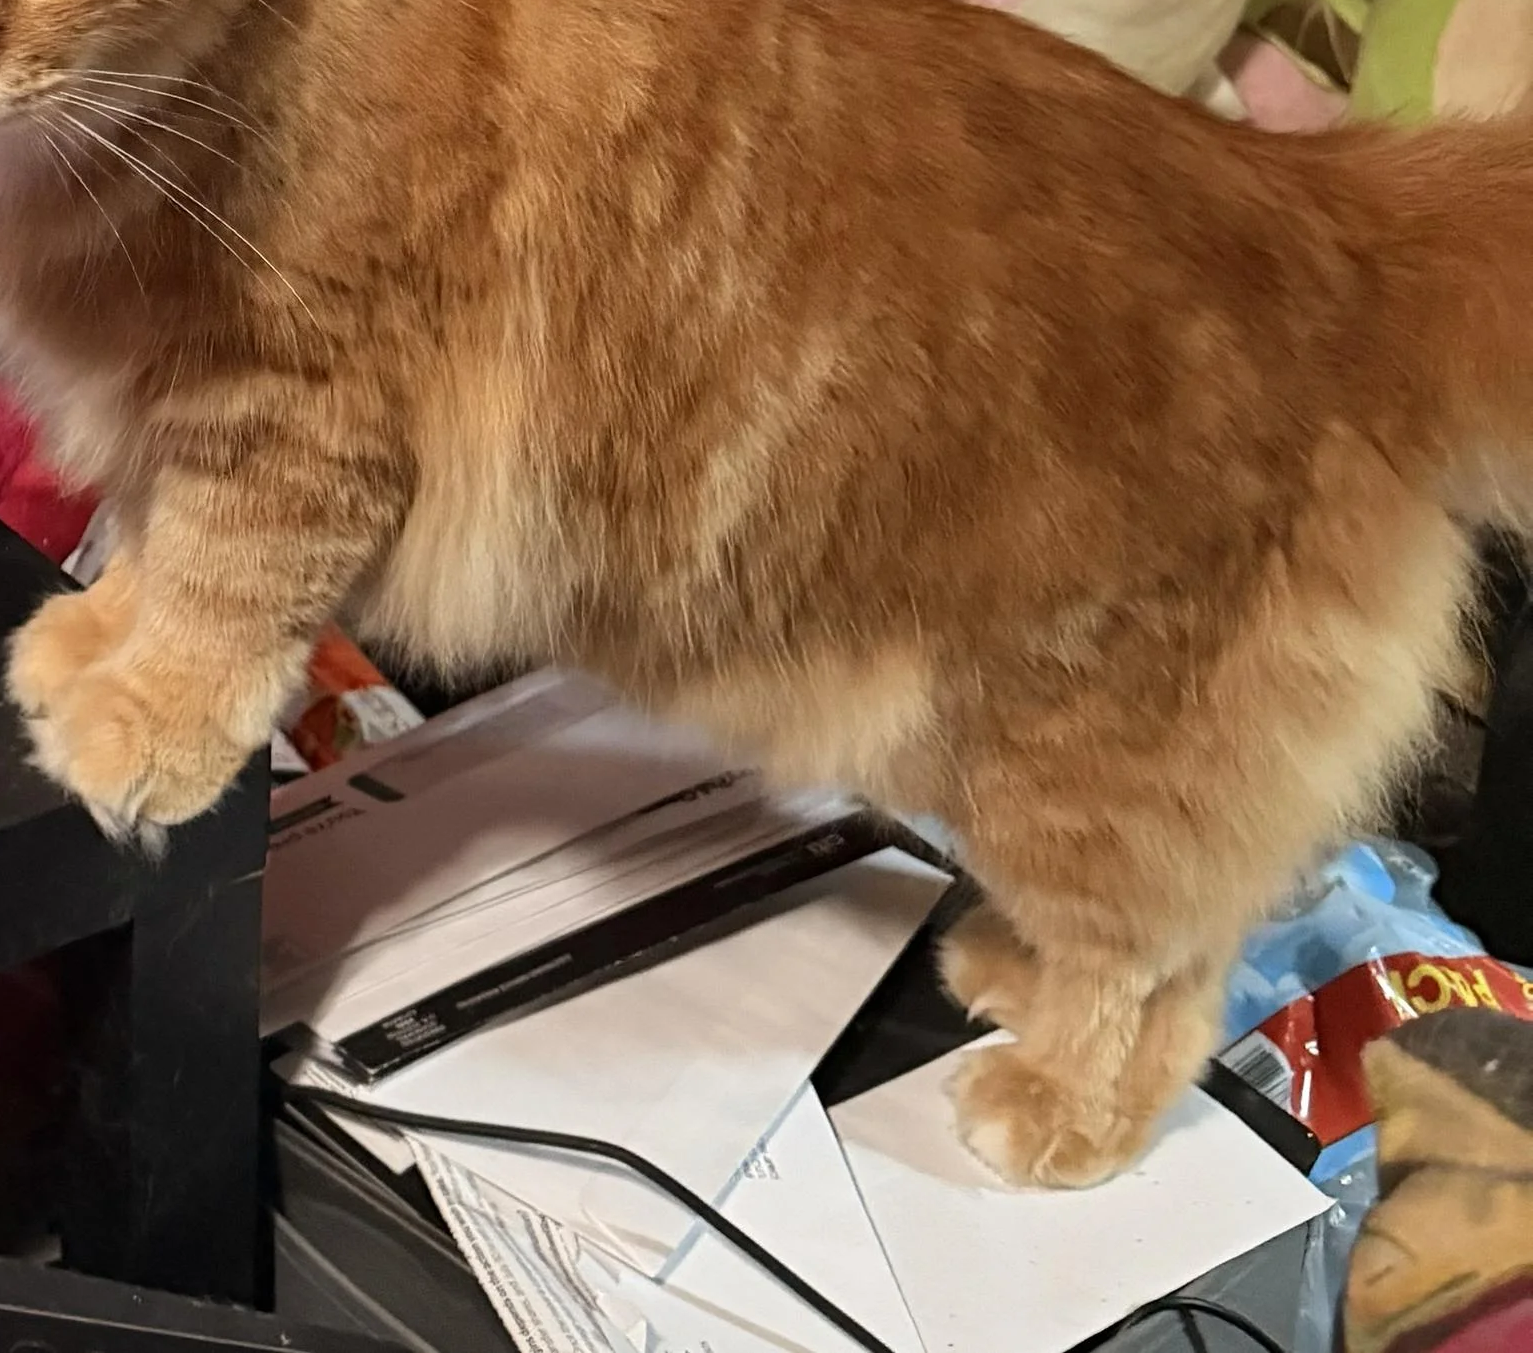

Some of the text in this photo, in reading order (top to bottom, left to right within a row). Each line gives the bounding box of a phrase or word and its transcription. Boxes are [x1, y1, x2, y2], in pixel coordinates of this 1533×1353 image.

[464, 1224, 476, 1243] you
[471, 1241, 491, 1270] action
[486, 1268, 501, 1286] the
[496, 1284, 508, 1298] on
[504, 1298, 531, 1338] depends
